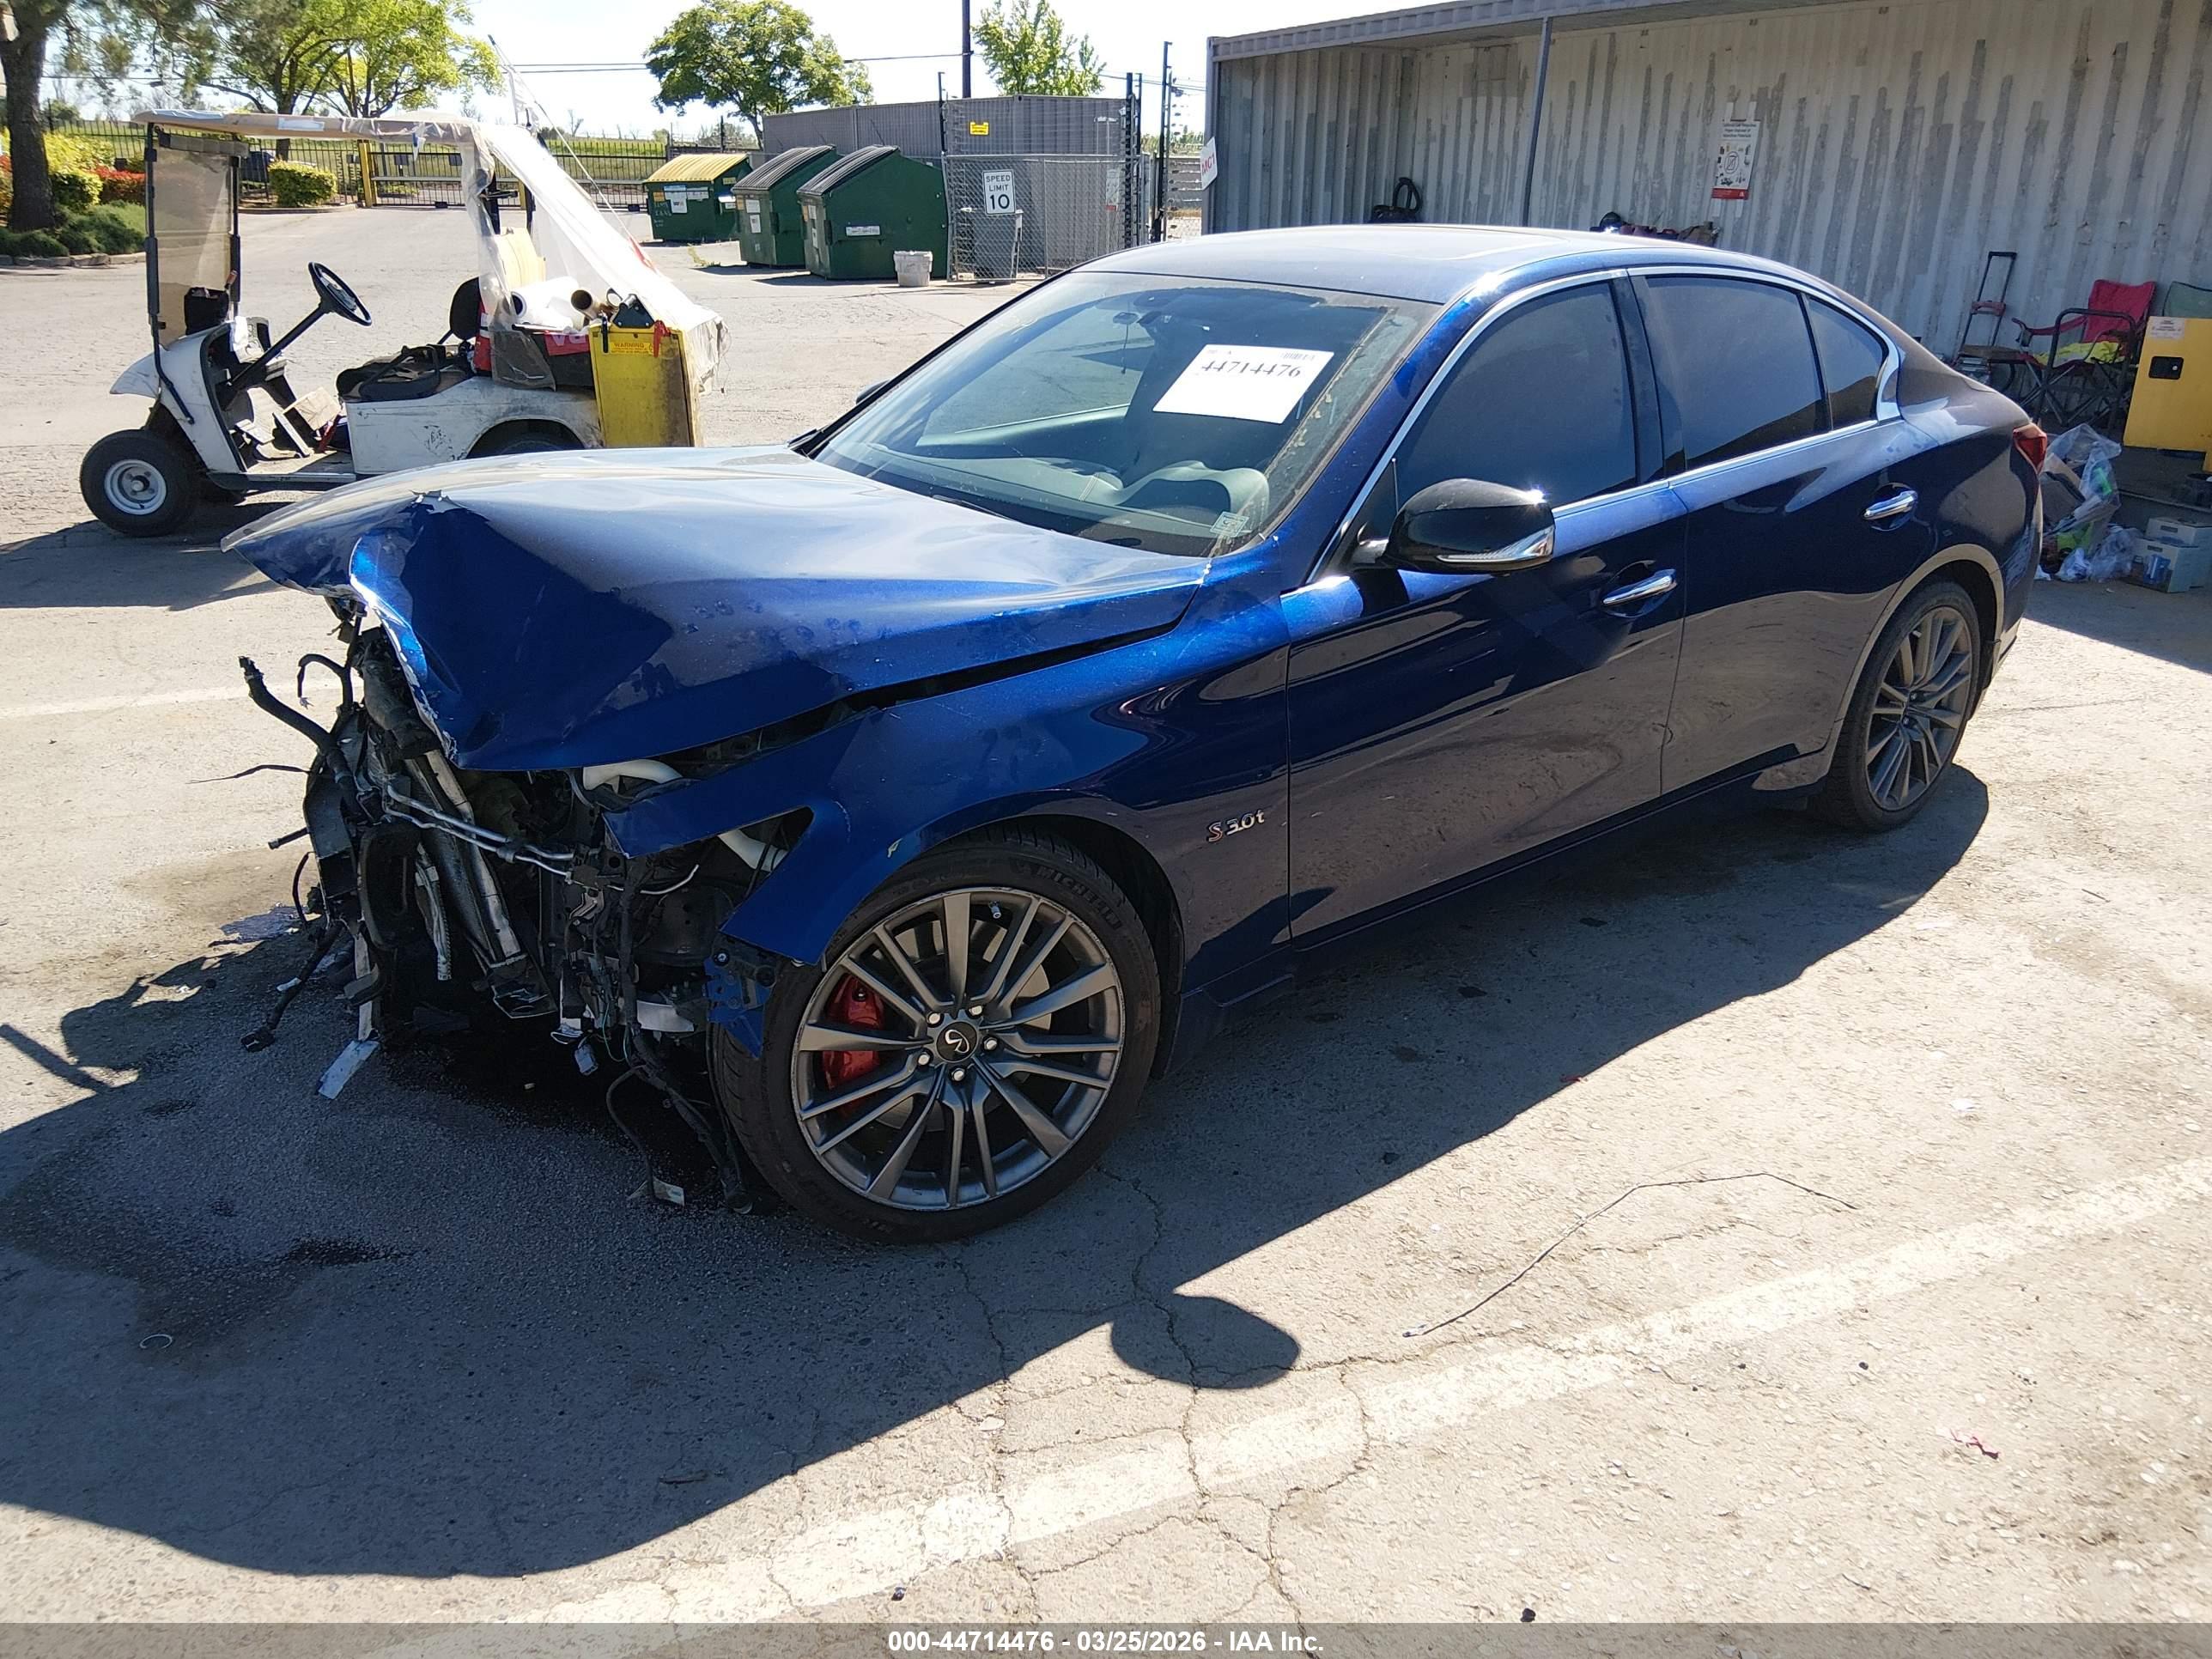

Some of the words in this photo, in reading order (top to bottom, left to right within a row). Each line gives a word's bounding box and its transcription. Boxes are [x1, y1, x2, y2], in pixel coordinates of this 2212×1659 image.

[986, 174, 1011, 183] SPEED
[989, 184, 1009, 192] LIMIT
[990, 194, 1010, 210] 10
[1201, 361, 1302, 377] 44714476
[1036, 866, 1125, 931] MICHELIN
